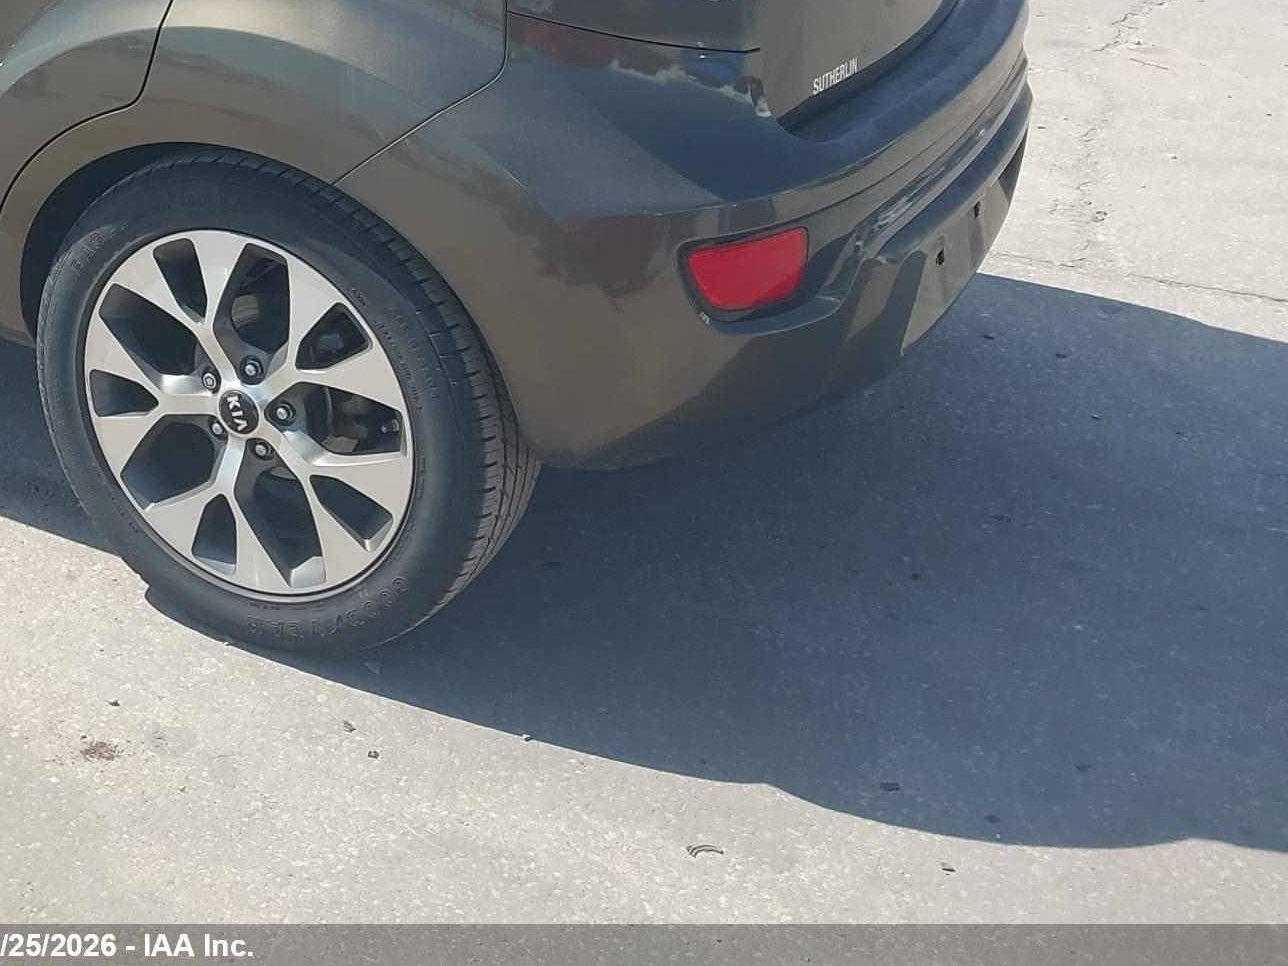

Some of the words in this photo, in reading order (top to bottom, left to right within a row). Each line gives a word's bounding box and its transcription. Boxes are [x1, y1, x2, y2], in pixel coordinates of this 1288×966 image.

[813, 56, 858, 95] SUTHERLIN
[226, 394, 248, 432] KIA
[247, 576, 410, 638] GOODYEAR
